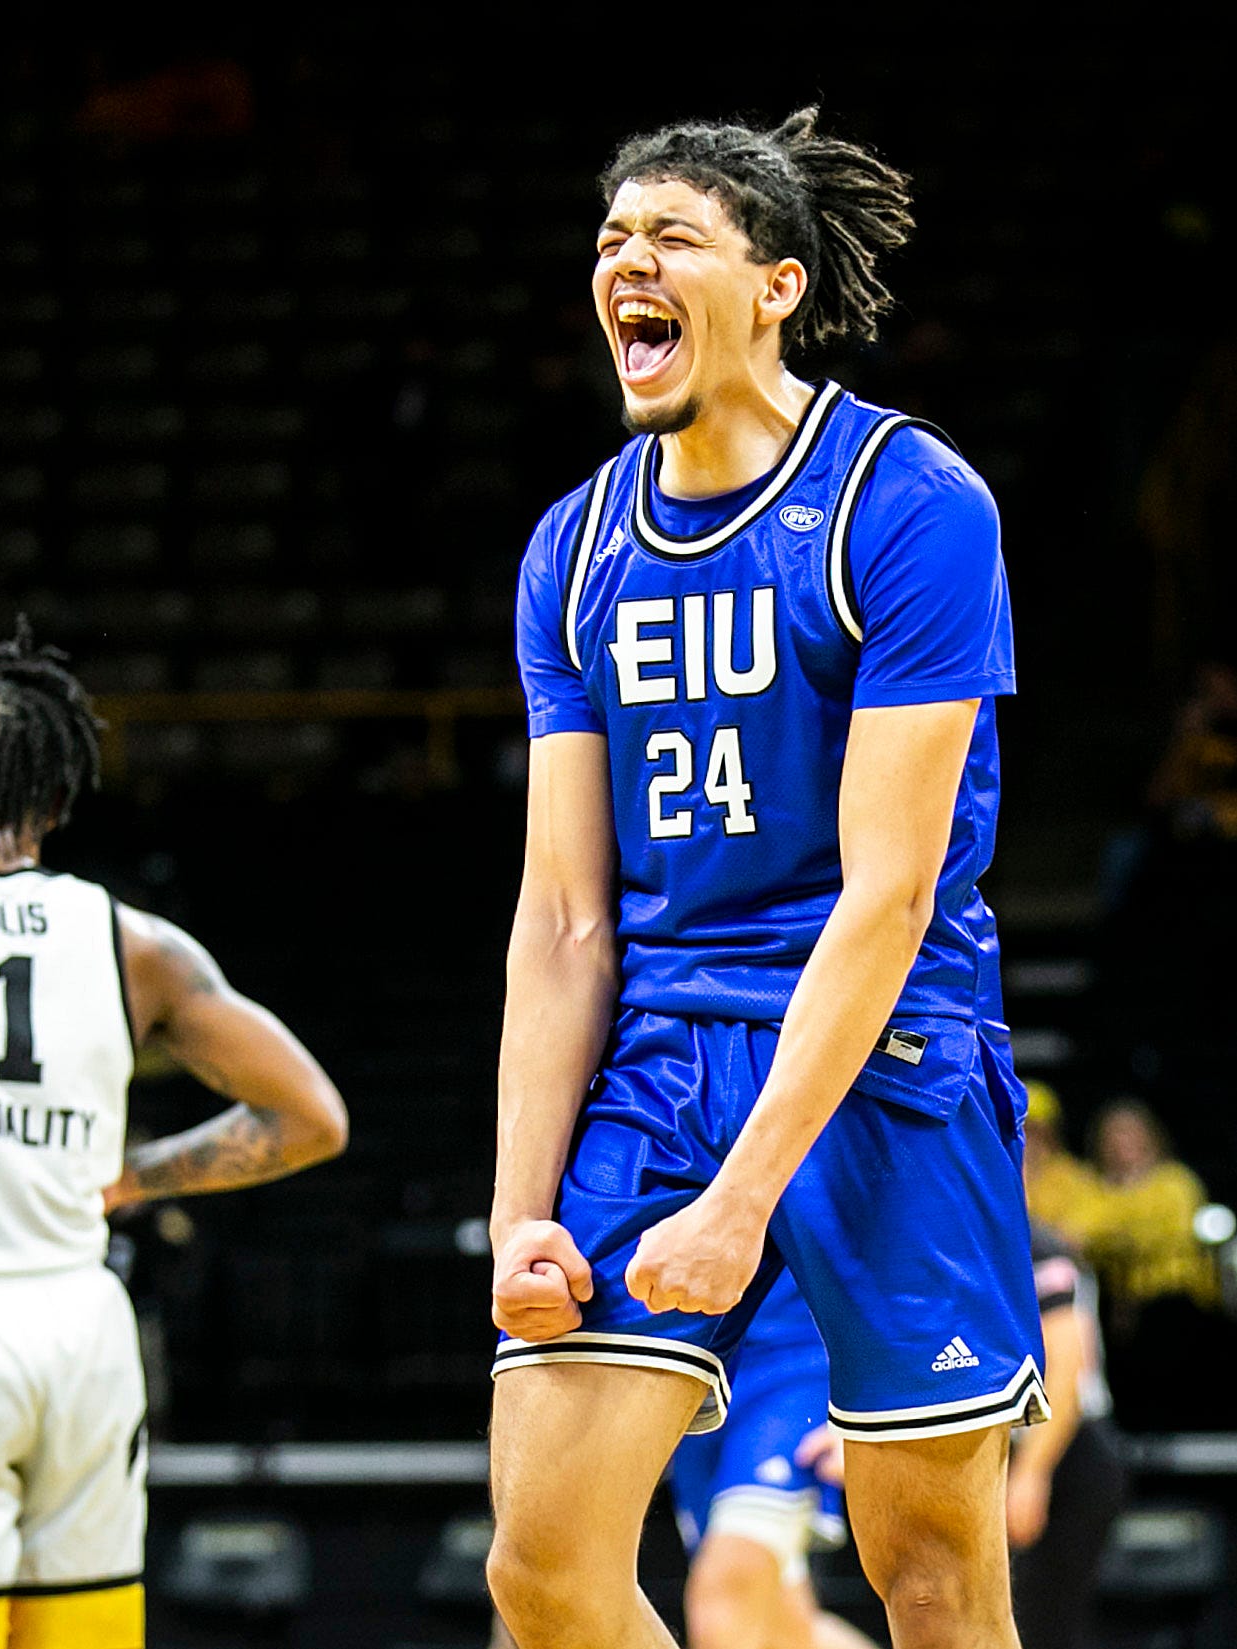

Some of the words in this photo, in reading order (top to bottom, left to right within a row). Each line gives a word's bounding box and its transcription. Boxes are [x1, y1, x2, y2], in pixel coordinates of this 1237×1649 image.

[607, 587, 777, 705] EIU
[646, 727, 757, 838] 24
[931, 1356, 980, 1372] adidas
